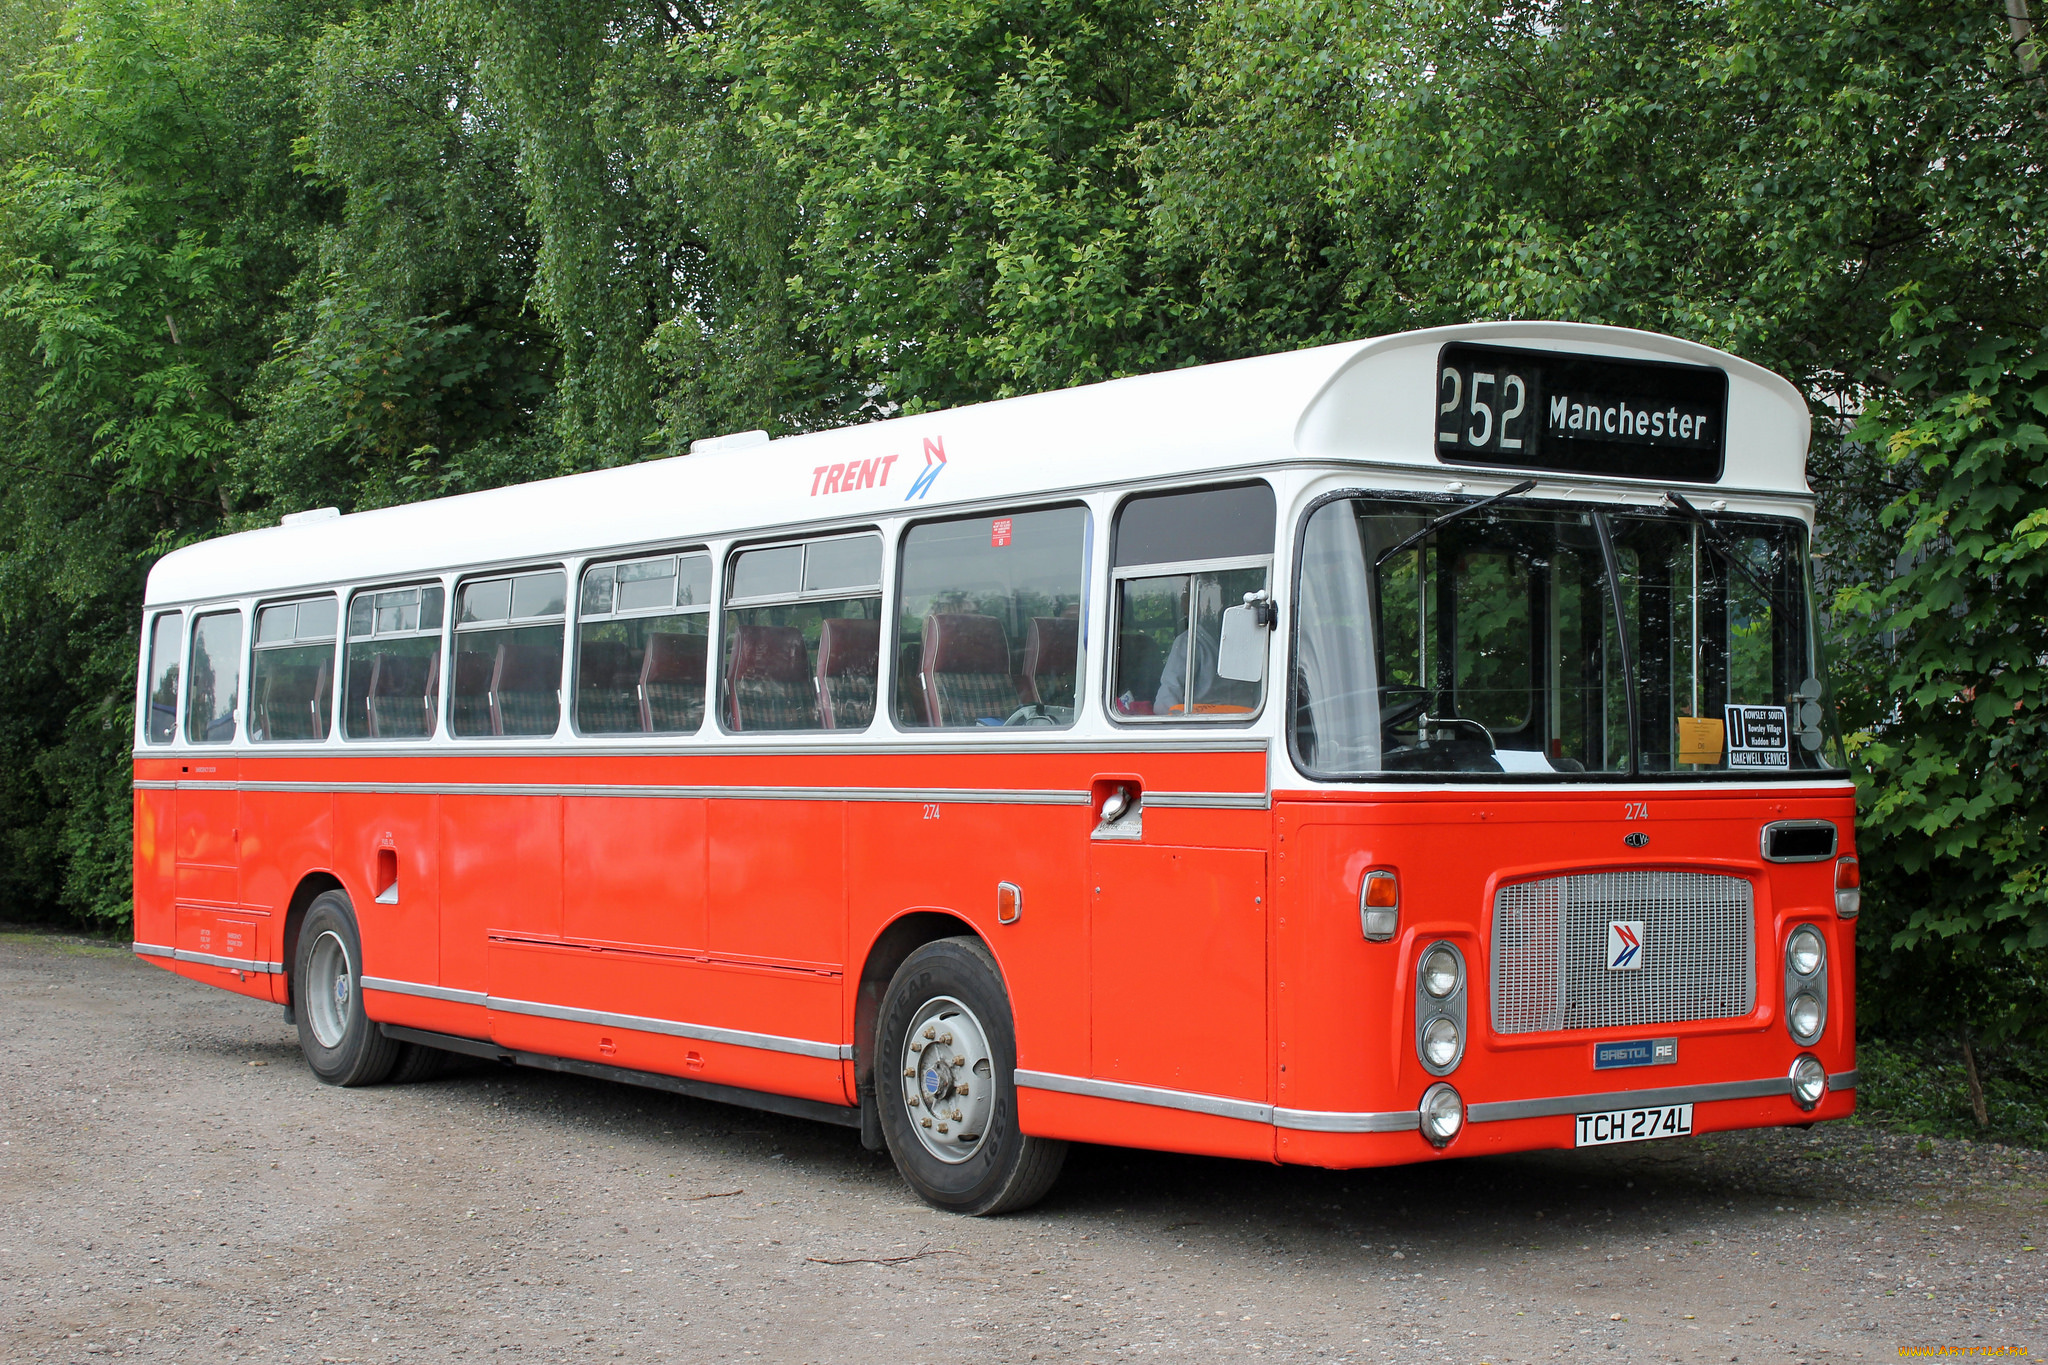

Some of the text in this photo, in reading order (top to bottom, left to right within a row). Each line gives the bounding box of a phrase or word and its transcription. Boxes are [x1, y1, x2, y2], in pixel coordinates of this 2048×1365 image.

[1439, 367, 1707, 448] 252 Manchester
[810, 454, 899, 496] TRENT
[1744, 710, 1766, 720] ROWSLEY
[1768, 710, 1783, 720] SOUTH
[1748, 724, 1782, 735] Rowsley Village
[1770, 737, 1781, 746] Hall
[1732, 752, 1786, 765] BAKEWELL SERVICE
[923, 804, 940, 819] 274
[1624, 802, 1648, 820] 274
[1600, 1045, 1672, 1061] BRISTOL AE
[1578, 1107, 1690, 1143] TCH 274L
